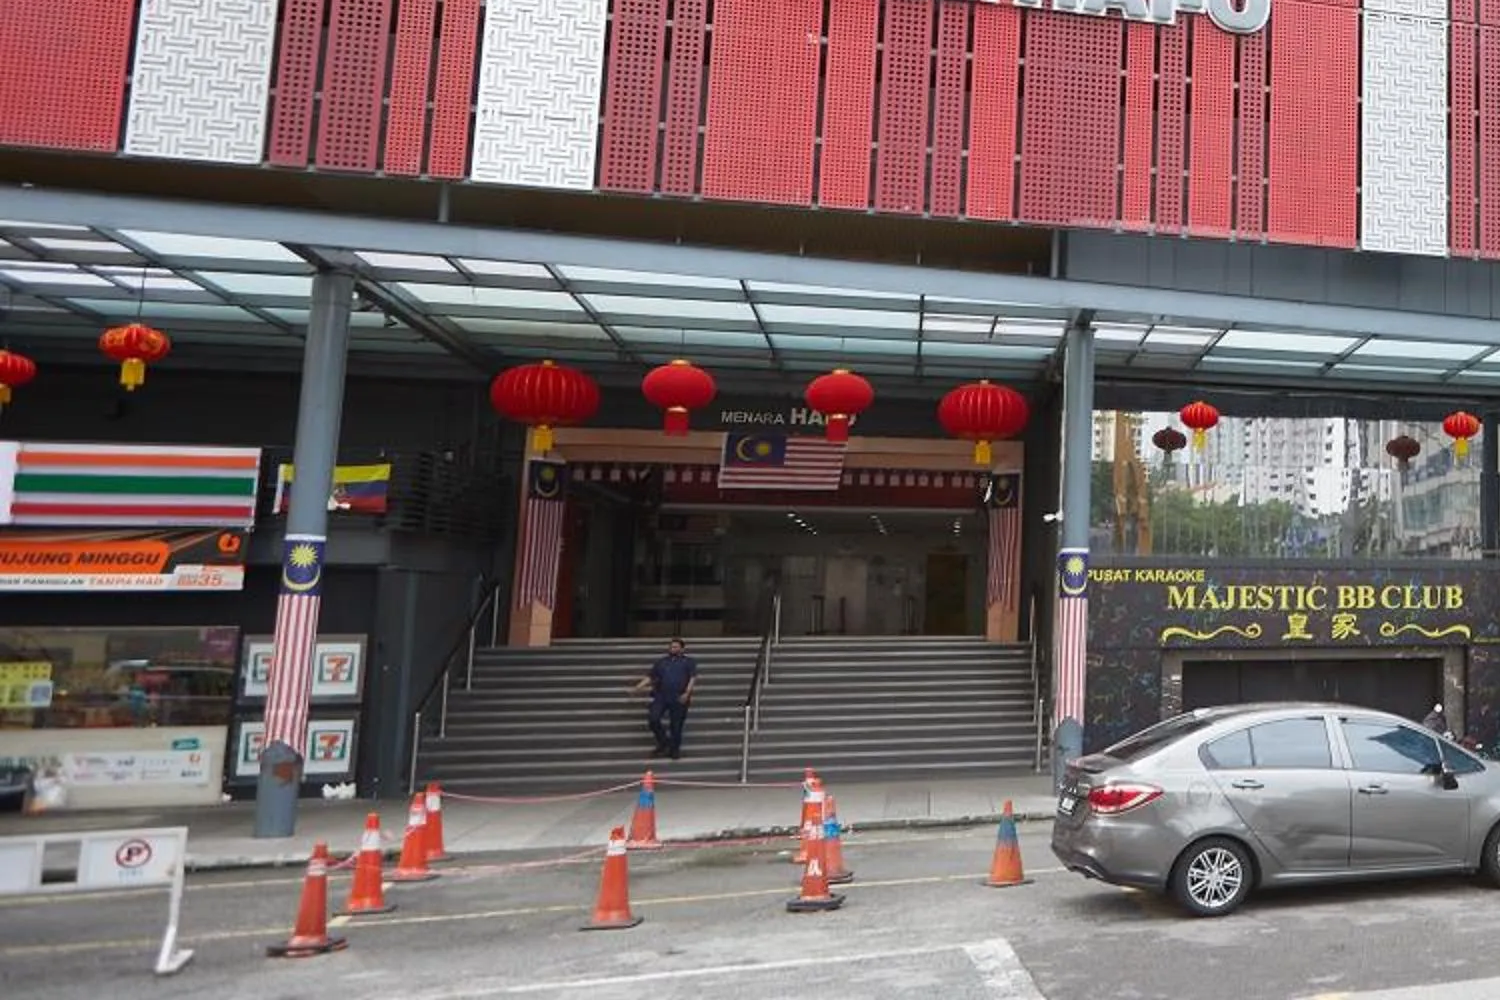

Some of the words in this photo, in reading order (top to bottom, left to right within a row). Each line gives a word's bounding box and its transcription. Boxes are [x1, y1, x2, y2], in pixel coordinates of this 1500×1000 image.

[721, 411, 784, 424] MENARA
[77, 550, 161, 566] MINGGU
[1135, 569, 1205, 582] KARAOKE
[1167, 585, 1327, 611] MAJESTIC
[1337, 585, 1376, 610] BB
[1380, 585, 1464, 610] CLUB
[1281, 612, 1361, 640] 皇家
